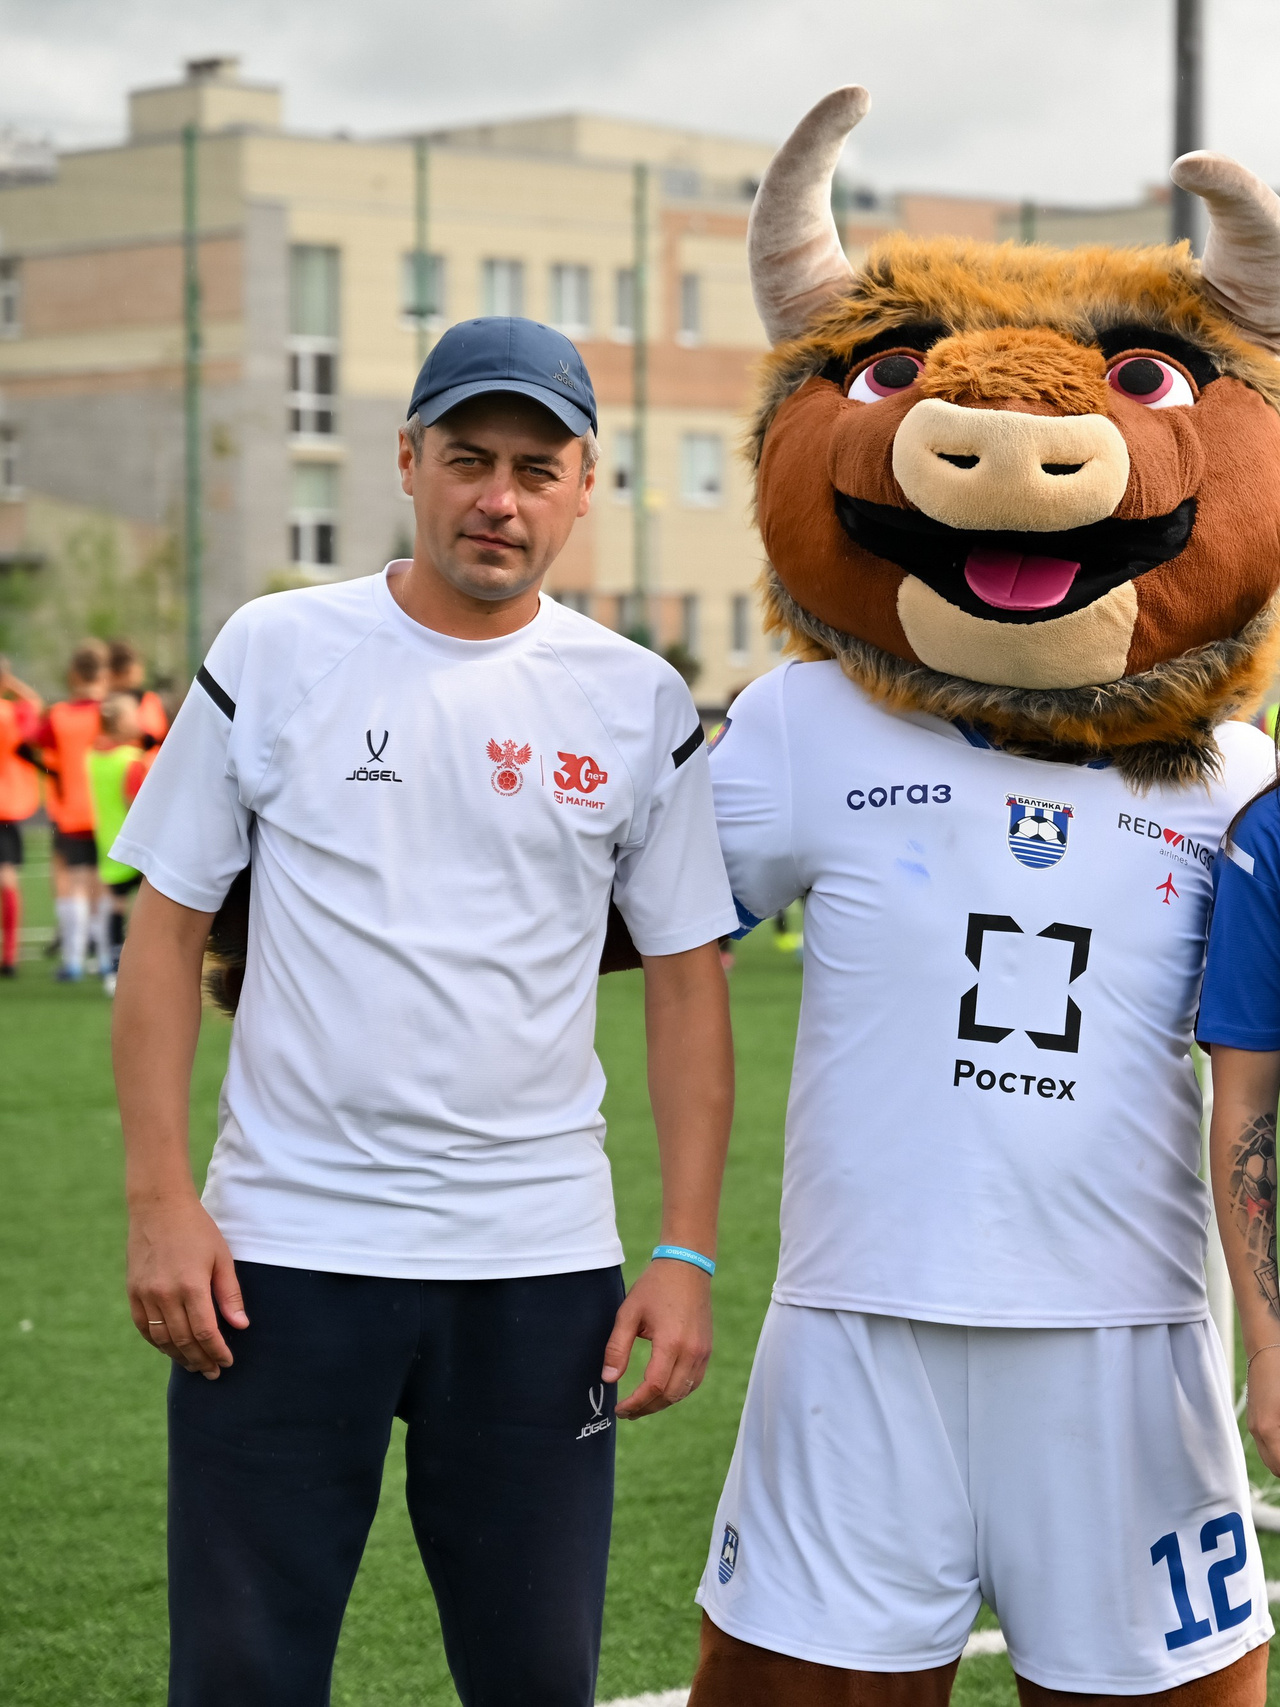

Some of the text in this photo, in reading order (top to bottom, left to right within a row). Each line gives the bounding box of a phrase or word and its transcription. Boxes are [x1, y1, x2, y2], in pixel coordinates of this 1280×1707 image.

[345, 766, 403, 782] JÖGEL
[553, 750, 601, 794] 30
[587, 771, 605, 781] лет
[565, 795, 606, 810] МАГНИТ
[1017, 796, 1062, 812] БАЛТИКА
[1159, 847, 1188, 866] airlines
[953, 1058, 1077, 1102] Ростех
[575, 1417, 612, 1440] JÖGEL
[1150, 1511, 1252, 1651] 12
